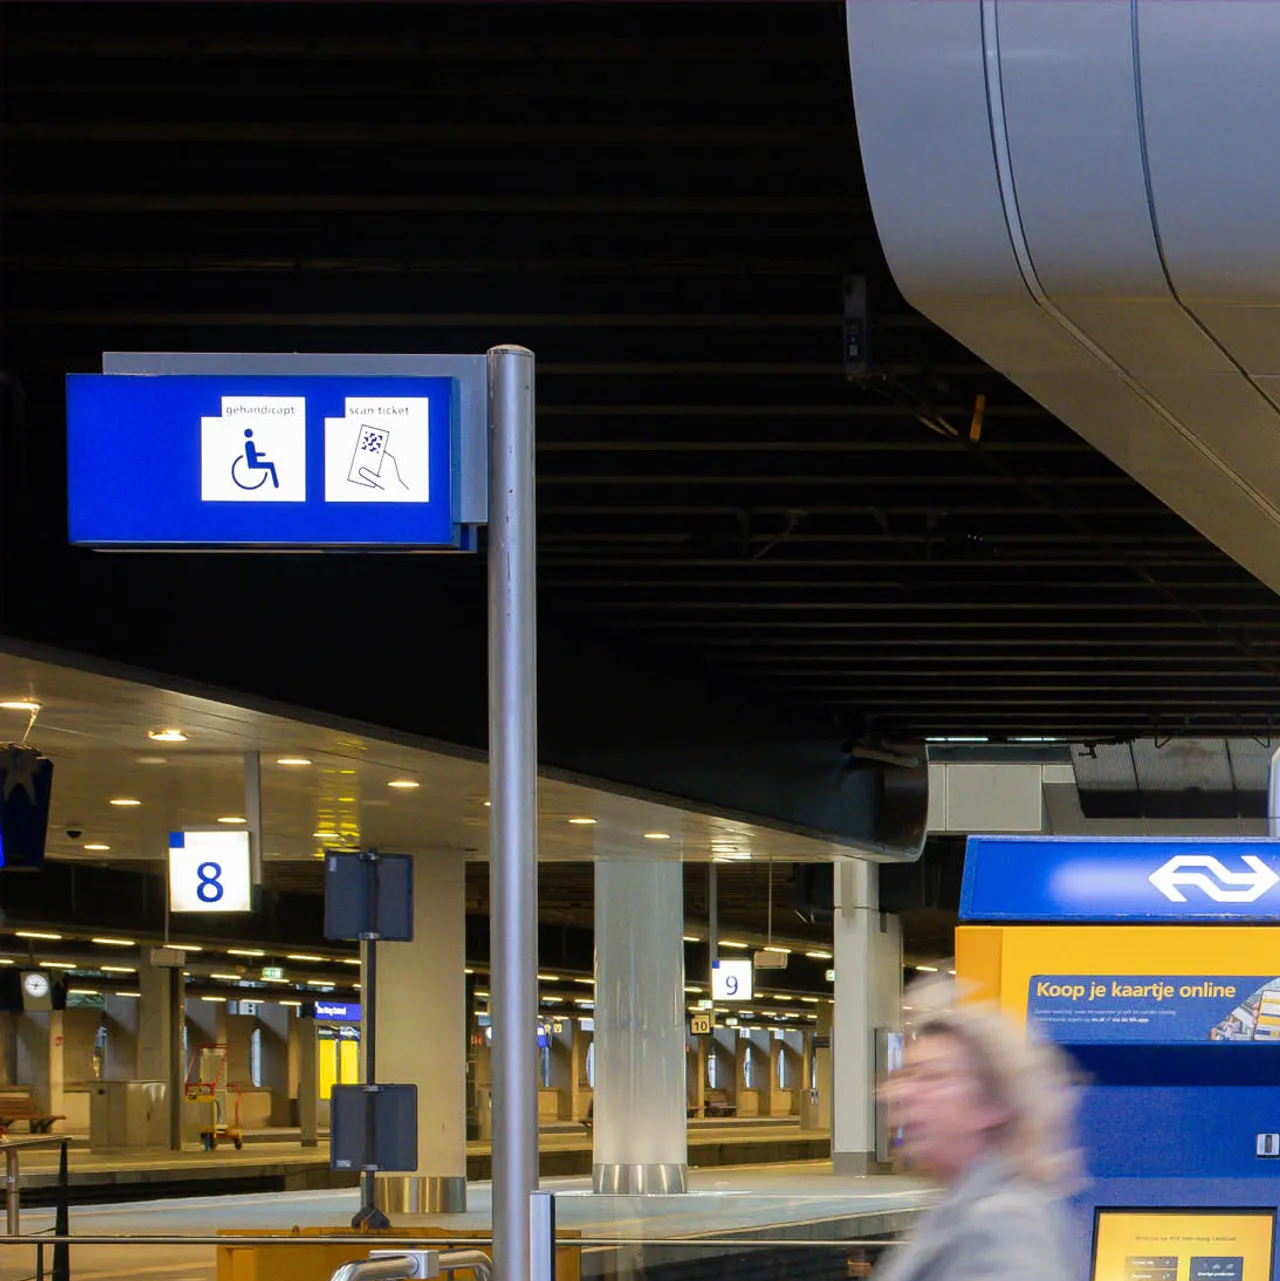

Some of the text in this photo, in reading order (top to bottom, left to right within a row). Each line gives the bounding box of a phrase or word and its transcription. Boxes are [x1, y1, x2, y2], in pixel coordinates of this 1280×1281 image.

[225, 405, 296, 417] gehandicapt
[349, 405, 410, 416] scan ticket
[196, 861, 224, 903] 8
[725, 975, 739, 996] 9
[1036, 981, 1237, 1001] Koop je kaartje online
[694, 1021, 708, 1032] 10
